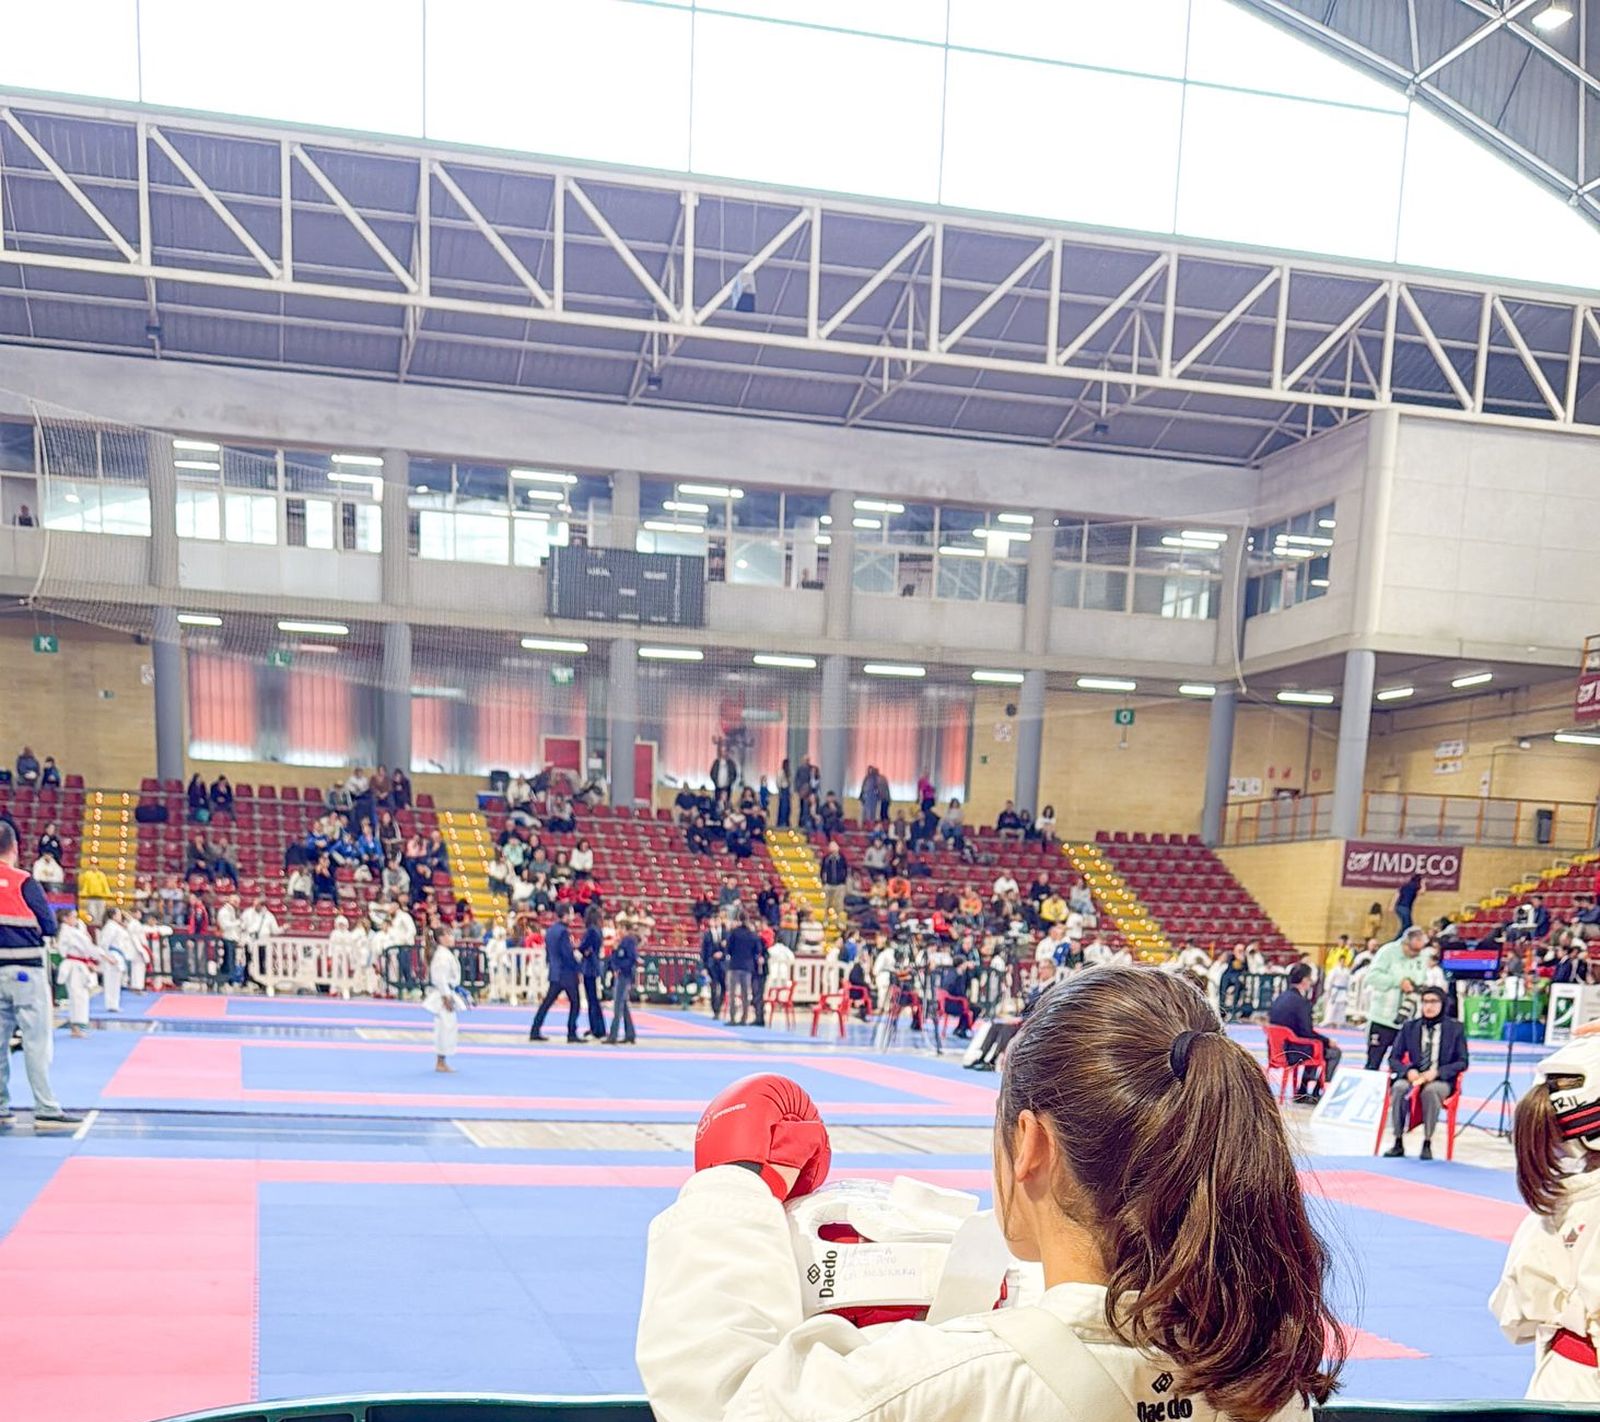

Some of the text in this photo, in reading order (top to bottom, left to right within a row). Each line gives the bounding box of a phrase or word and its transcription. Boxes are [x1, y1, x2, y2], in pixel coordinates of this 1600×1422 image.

[39, 637, 52, 651] K
[1372, 851, 1459, 876] IMDECO
[818, 1250, 838, 1298] Daedo
